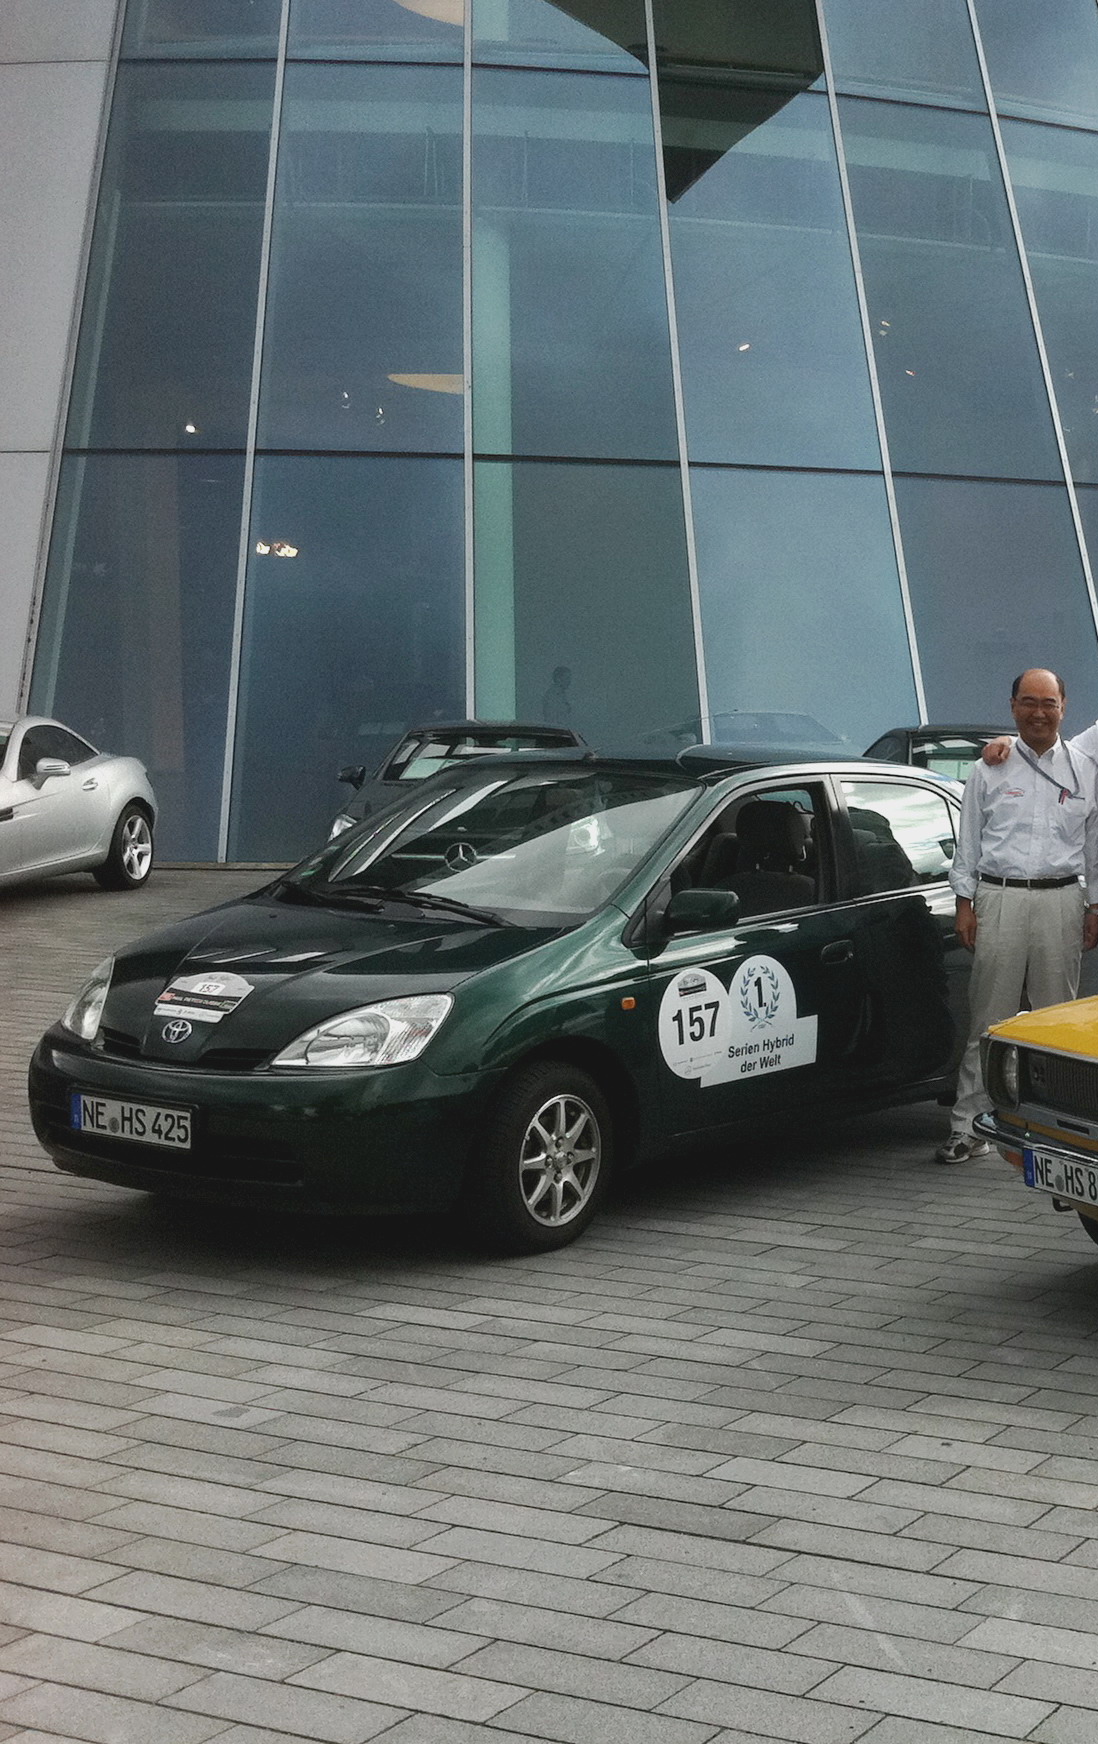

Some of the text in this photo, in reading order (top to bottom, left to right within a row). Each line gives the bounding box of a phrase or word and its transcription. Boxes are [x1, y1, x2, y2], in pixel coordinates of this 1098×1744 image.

[672, 1000, 720, 1046] 157
[727, 1033, 795, 1059] Serien Hybrid
[740, 1059, 757, 1073] der
[759, 1054, 782, 1070] Welt
[82, 1099, 189, 1144] NE HS 425
[1034, 1154, 1055, 1188] NE
[1063, 1164, 1085, 1197] HS
